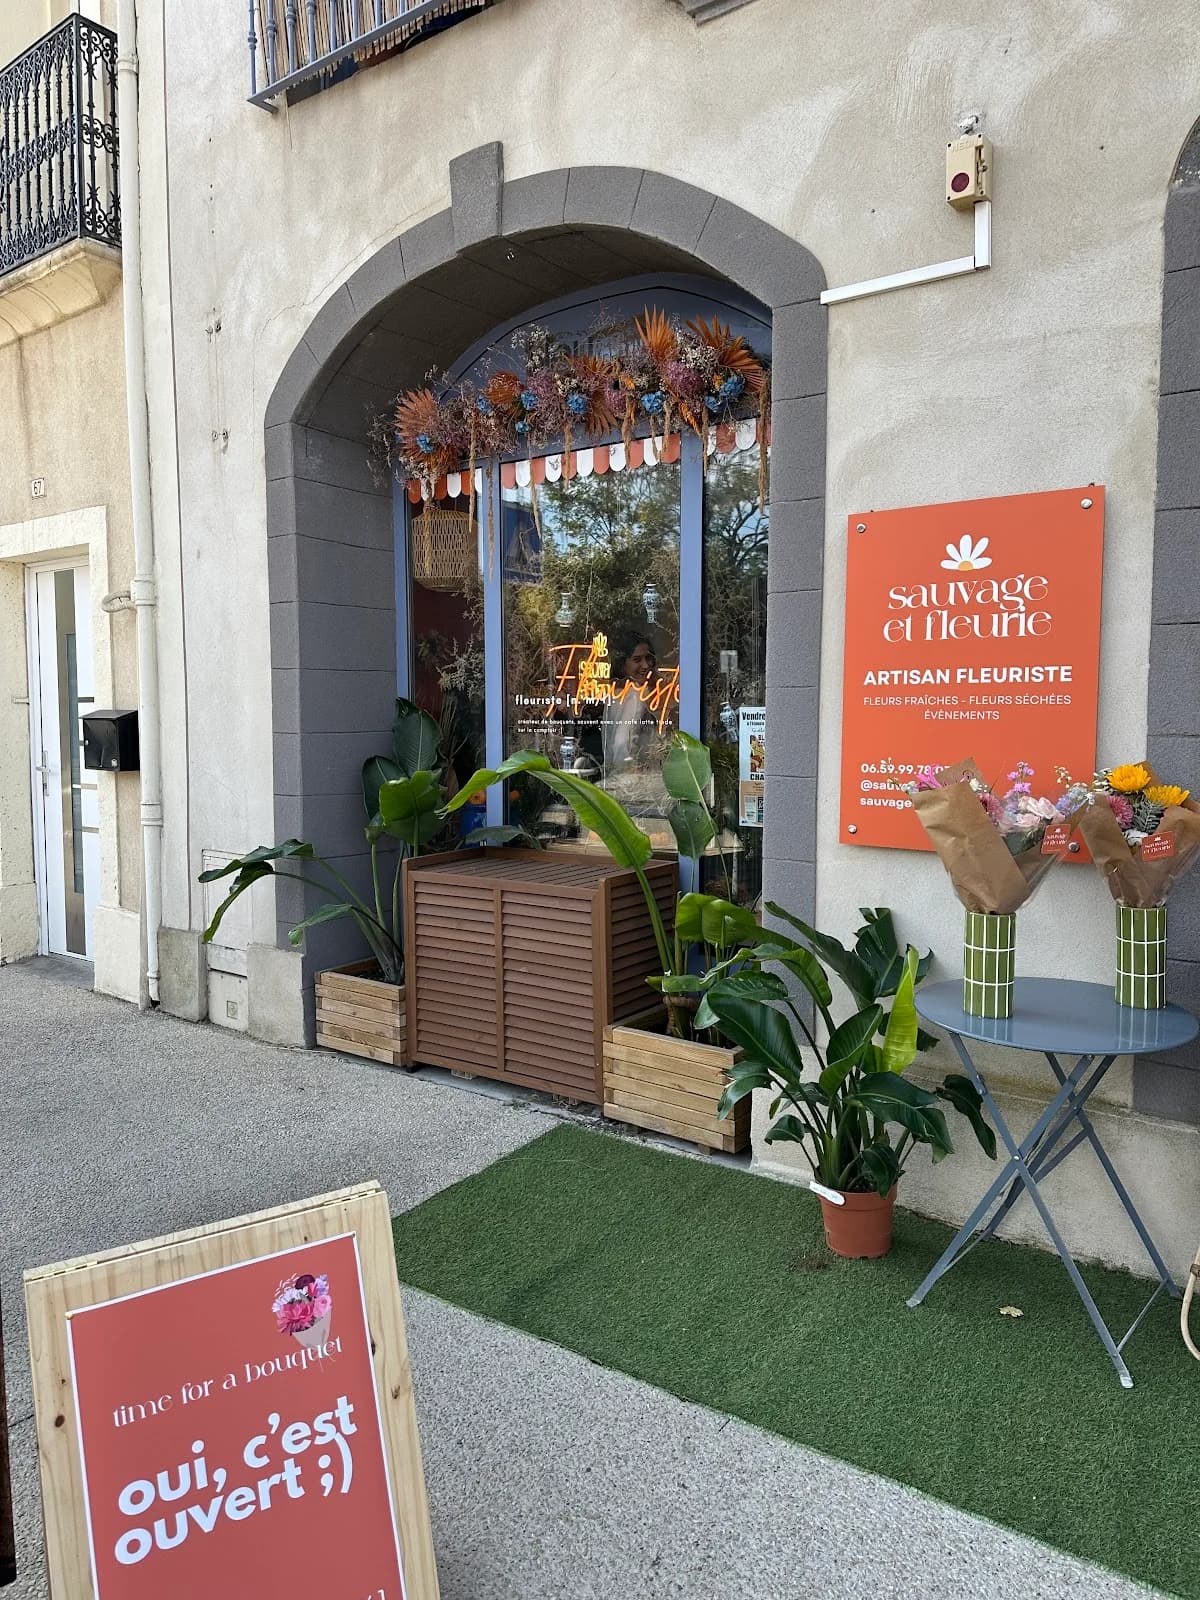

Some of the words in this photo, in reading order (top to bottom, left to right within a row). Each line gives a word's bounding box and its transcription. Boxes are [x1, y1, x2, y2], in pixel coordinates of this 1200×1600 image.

[33, 481, 42, 495] 67
[888, 574, 1048, 610] sauvage
[883, 614, 912, 642] et
[925, 606, 1052, 641] fleurie
[863, 669, 950, 686] ARTISAN
[957, 665, 1073, 684] FLEURISTE
[515, 694, 562, 705] fleuriste
[863, 696, 902, 706] FLEURS
[904, 694, 959, 706] FRAÎCHES
[969, 695, 1012, 706] FLEURS
[1015, 693, 1072, 705] SÉCHÉES
[113, 1394, 172, 1427] time
[181, 1379, 214, 1404] for
[223, 1373, 238, 1390] a
[245, 1336, 342, 1383] bouquet
[118, 1440, 227, 1516] oui,
[243, 1396, 358, 1468] c'est
[114, 1458, 305, 1565] ouvert
[321, 1432, 353, 1497] ;)
